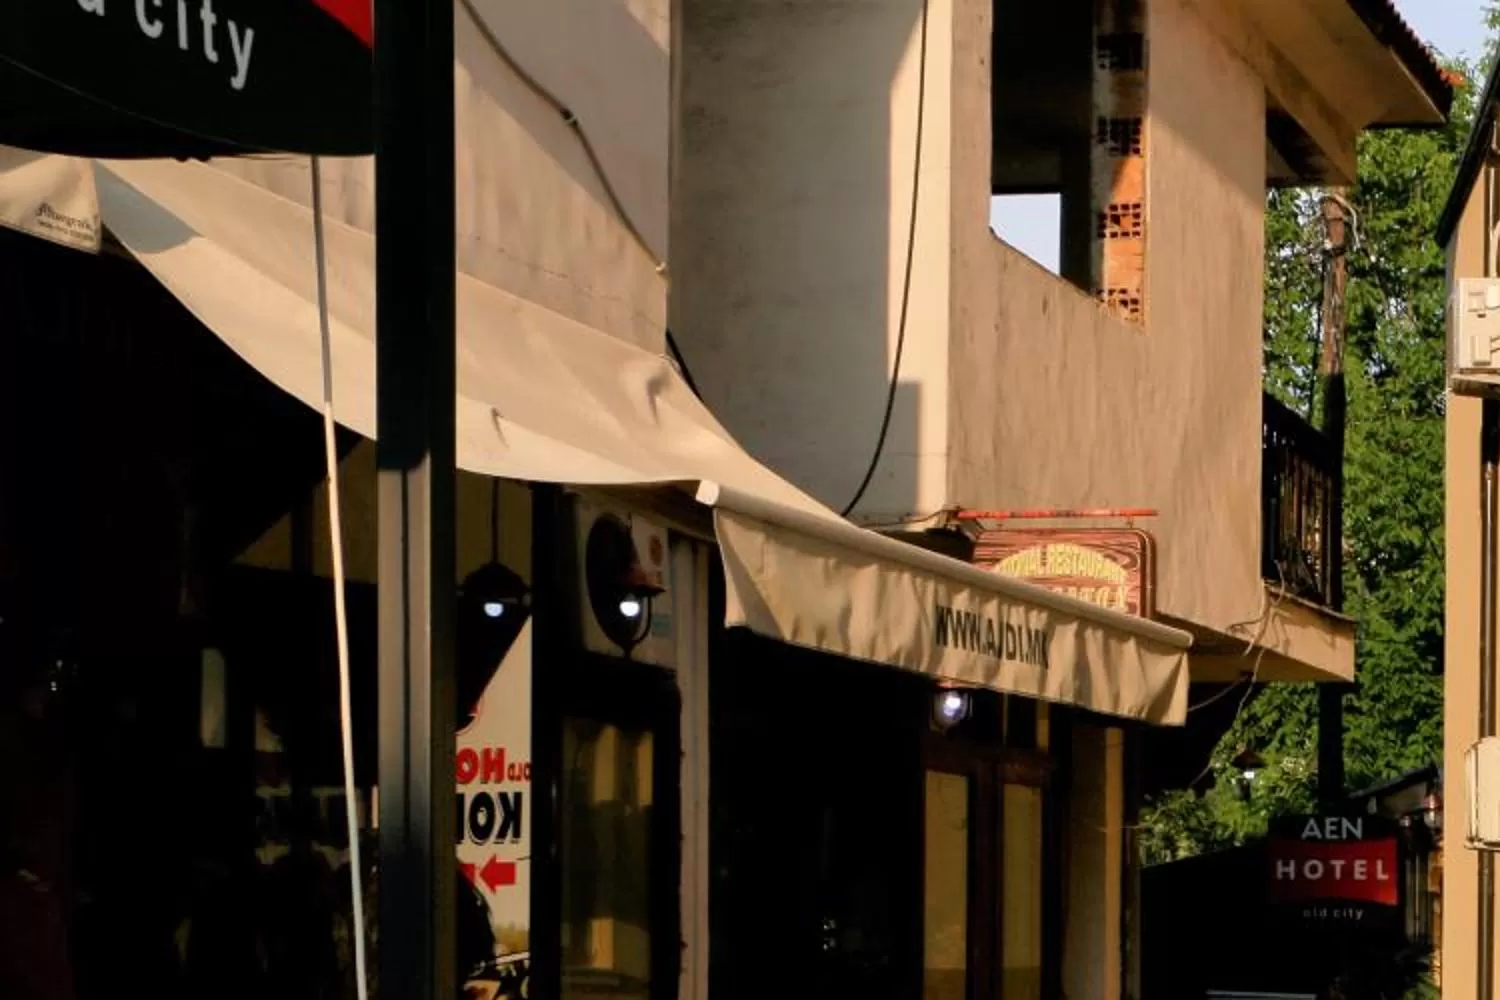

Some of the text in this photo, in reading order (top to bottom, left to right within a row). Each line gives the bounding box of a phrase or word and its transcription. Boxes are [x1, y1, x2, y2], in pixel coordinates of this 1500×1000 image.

[135, 0, 254, 90] city
[1301, 816, 1364, 840] AEN
[1276, 859, 1389, 881] HOTEL
[1332, 906, 1365, 921] city
